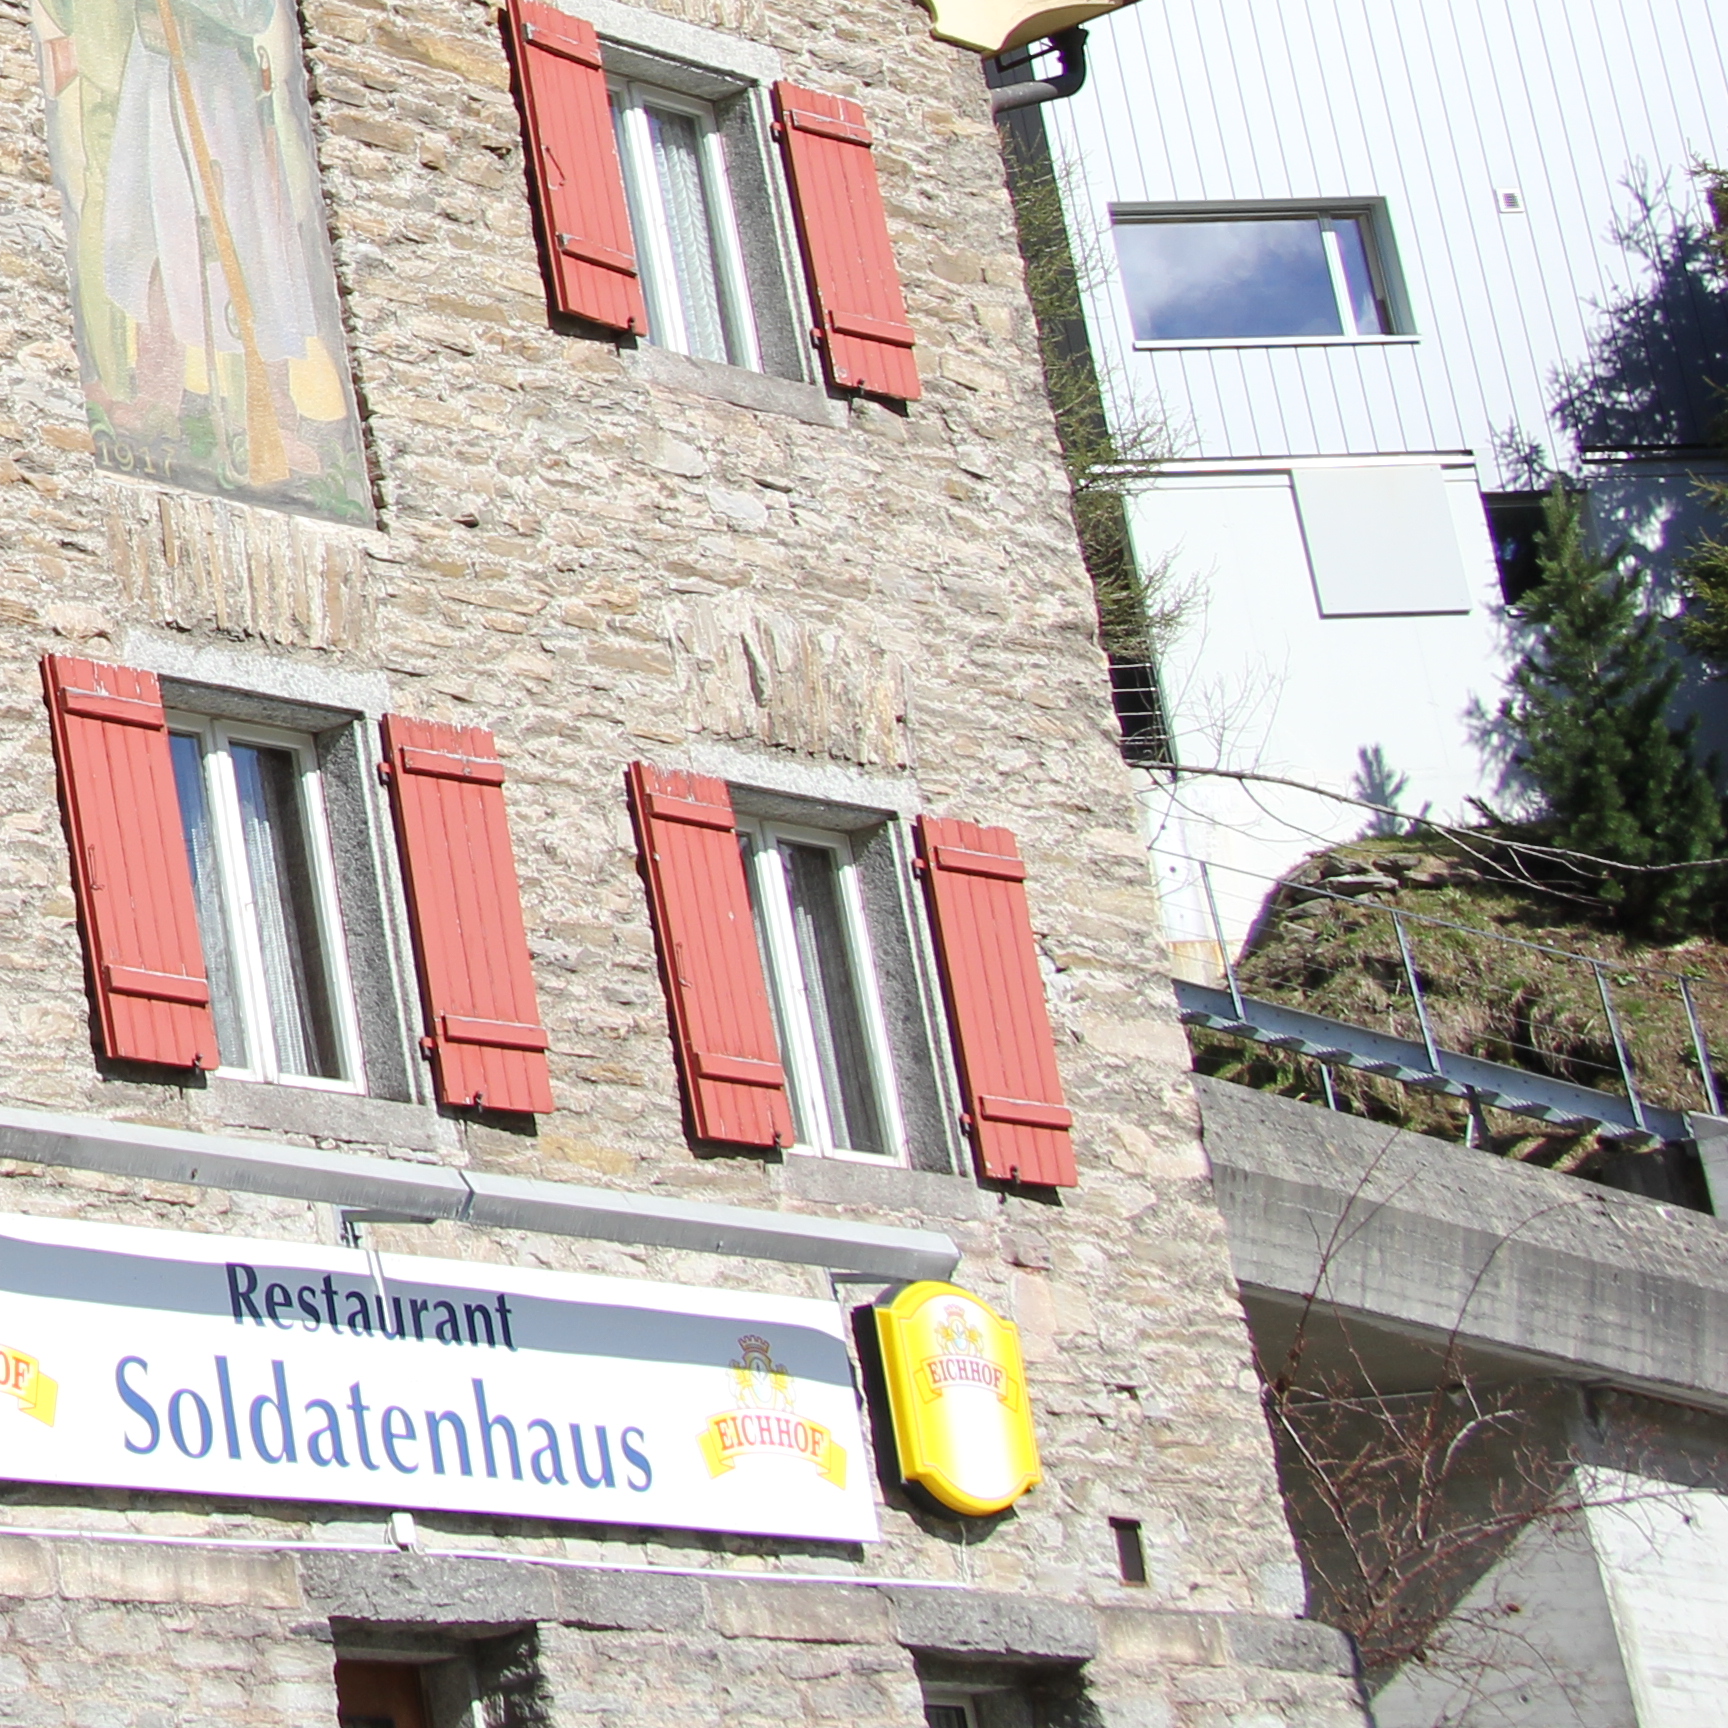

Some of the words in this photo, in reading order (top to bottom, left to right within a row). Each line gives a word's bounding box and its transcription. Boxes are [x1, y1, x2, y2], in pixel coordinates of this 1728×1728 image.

[97, 441, 177, 478] 1917
[225, 1261, 519, 1352] Restaurant
[927, 1358, 1003, 1389] EICHHOF
[115, 1354, 653, 1493] Soldatenhaus
[714, 1414, 825, 1458] EICHHOF
